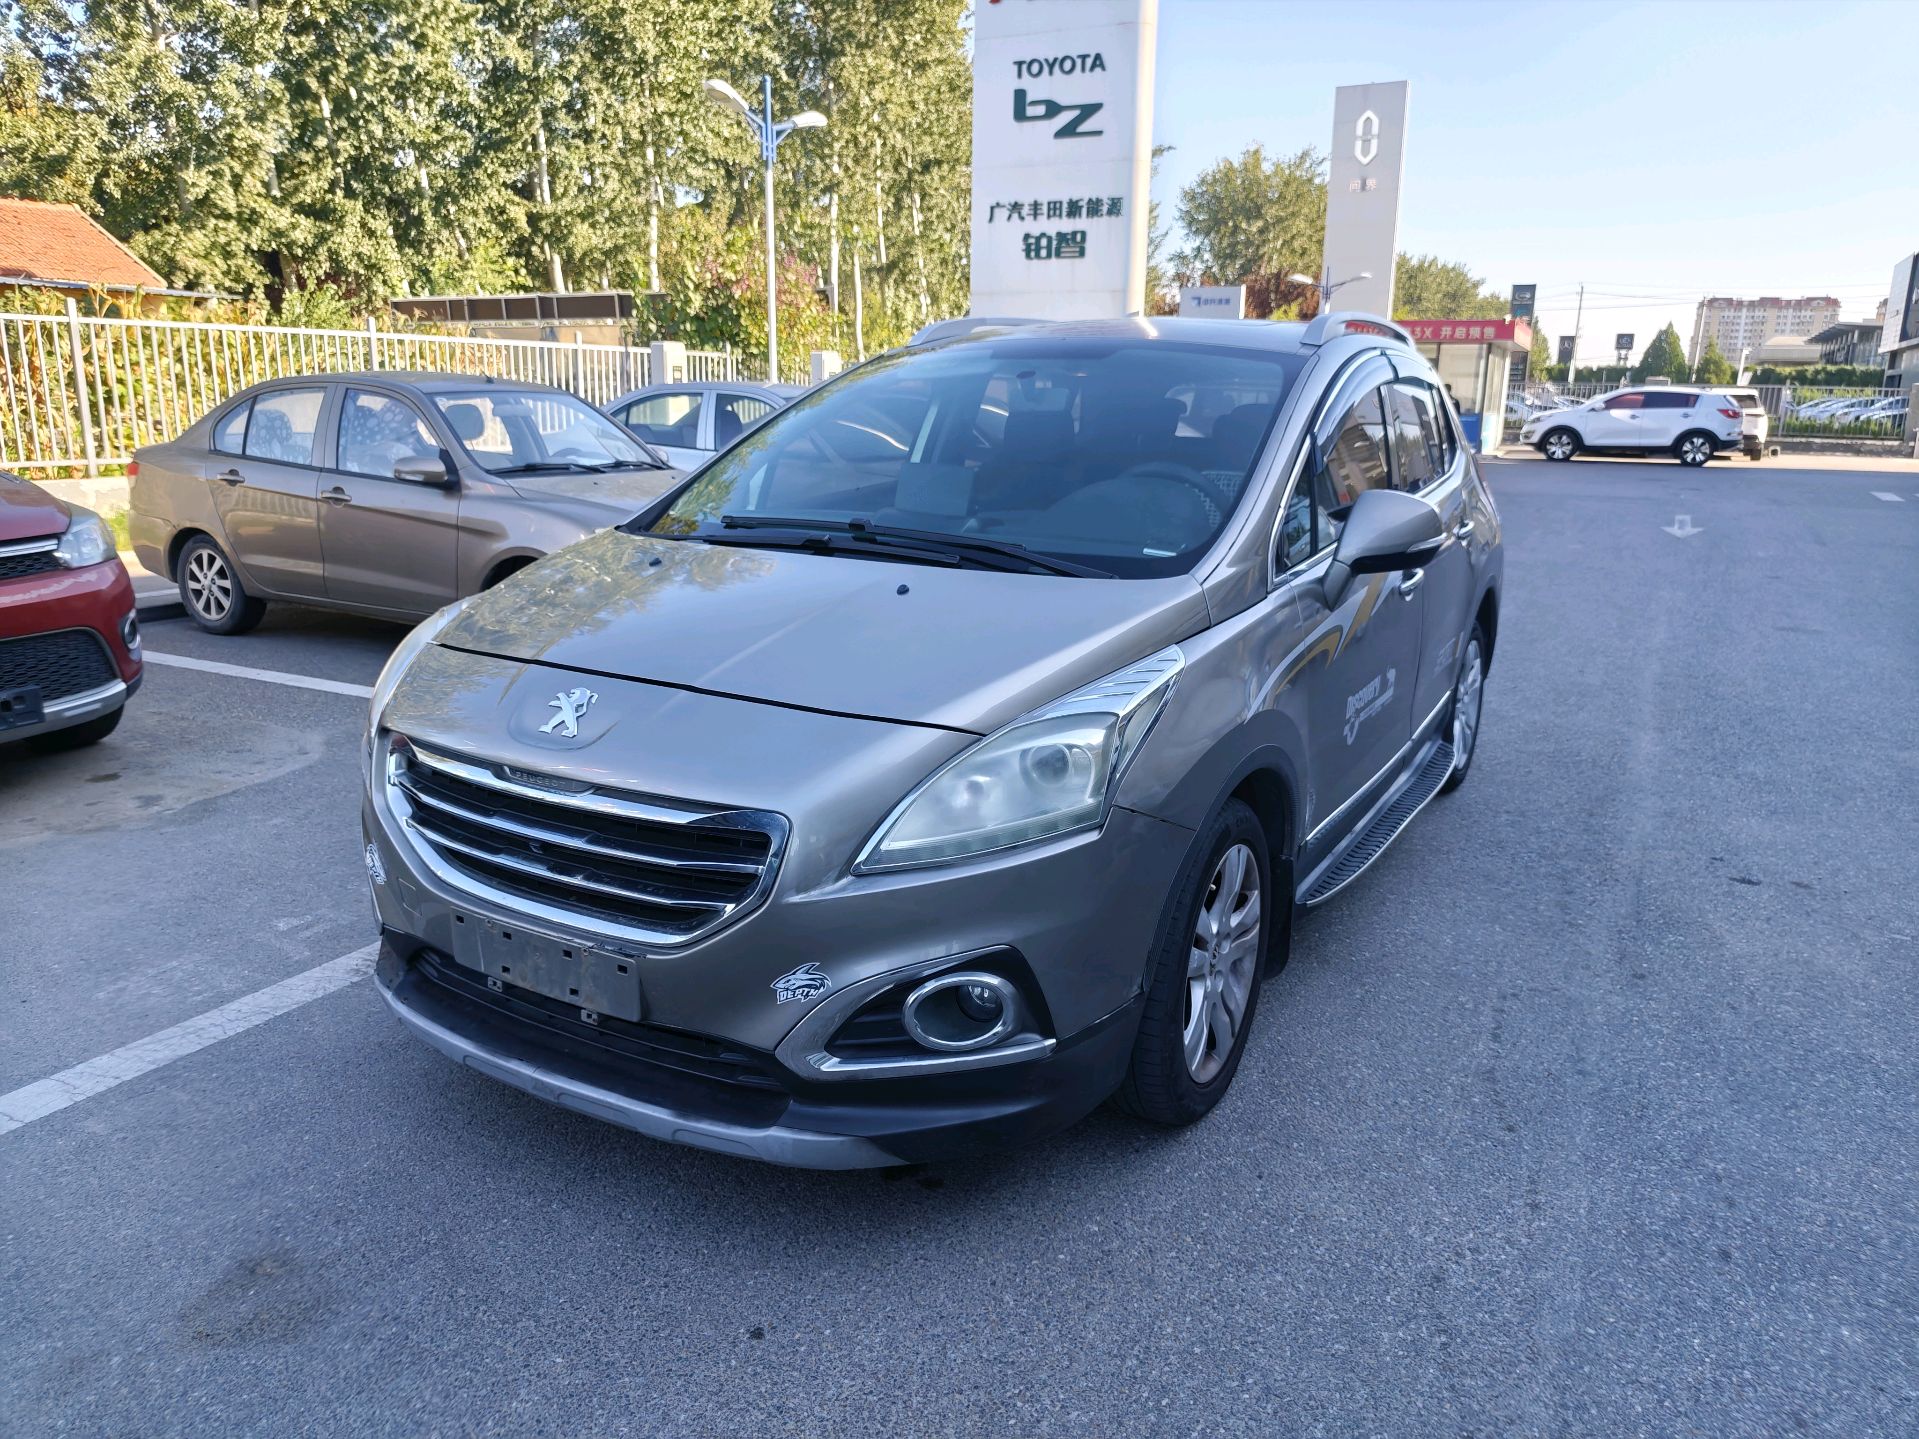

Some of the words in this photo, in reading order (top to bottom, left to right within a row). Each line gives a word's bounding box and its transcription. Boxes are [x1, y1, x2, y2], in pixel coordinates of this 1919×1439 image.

[1012, 52, 1106, 80] TOYOTA
[1349, 178, 1377, 192] 问界
[988, 197, 1123, 224] 广汽丰田新能源
[1021, 230, 1087, 260] 铂智
[1440, 326, 1496, 340] 开启预售
[779, 988, 819, 1001] DEPTH
